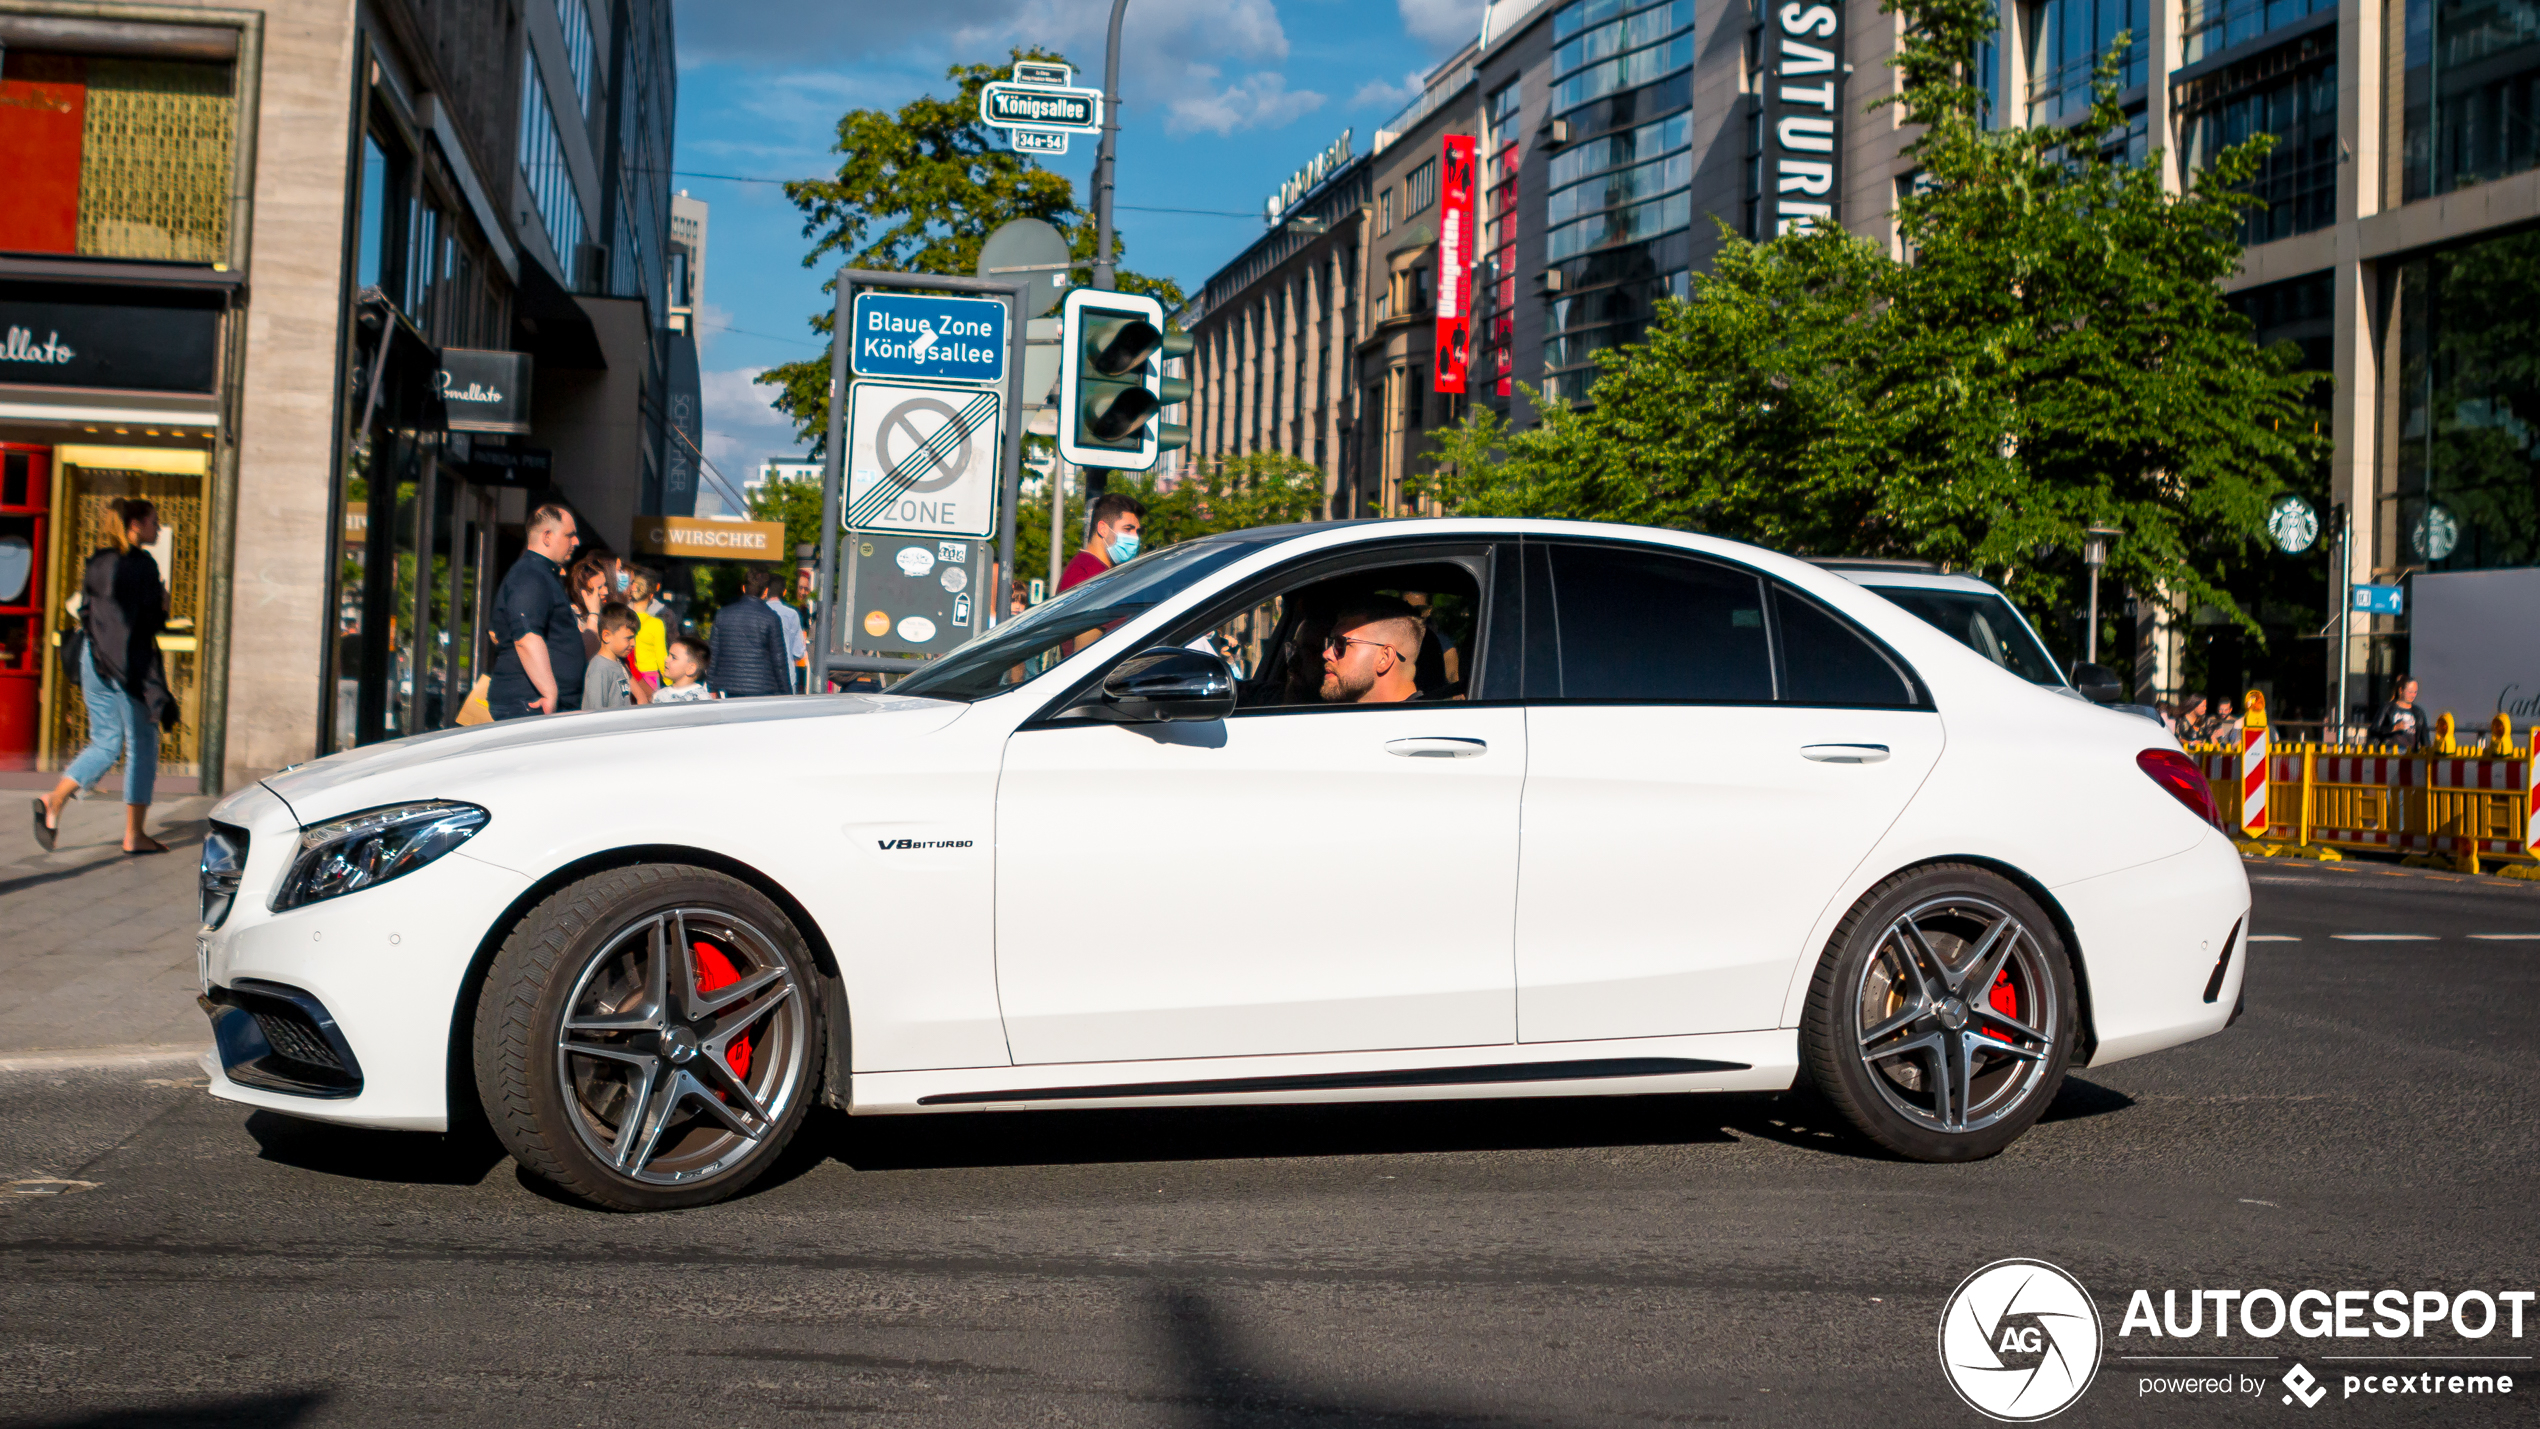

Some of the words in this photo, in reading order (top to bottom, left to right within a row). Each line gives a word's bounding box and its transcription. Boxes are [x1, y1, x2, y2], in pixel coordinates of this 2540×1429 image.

[998, 95, 1084, 119] Königsallee
[1020, 134, 1061, 149] 34a-54
[868, 311, 931, 333] Blaue
[938, 315, 993, 337] Zone
[864, 337, 995, 365] Königsallee
[883, 499, 957, 525] ZONE
[668, 529, 767, 549] WIRSCHKE
